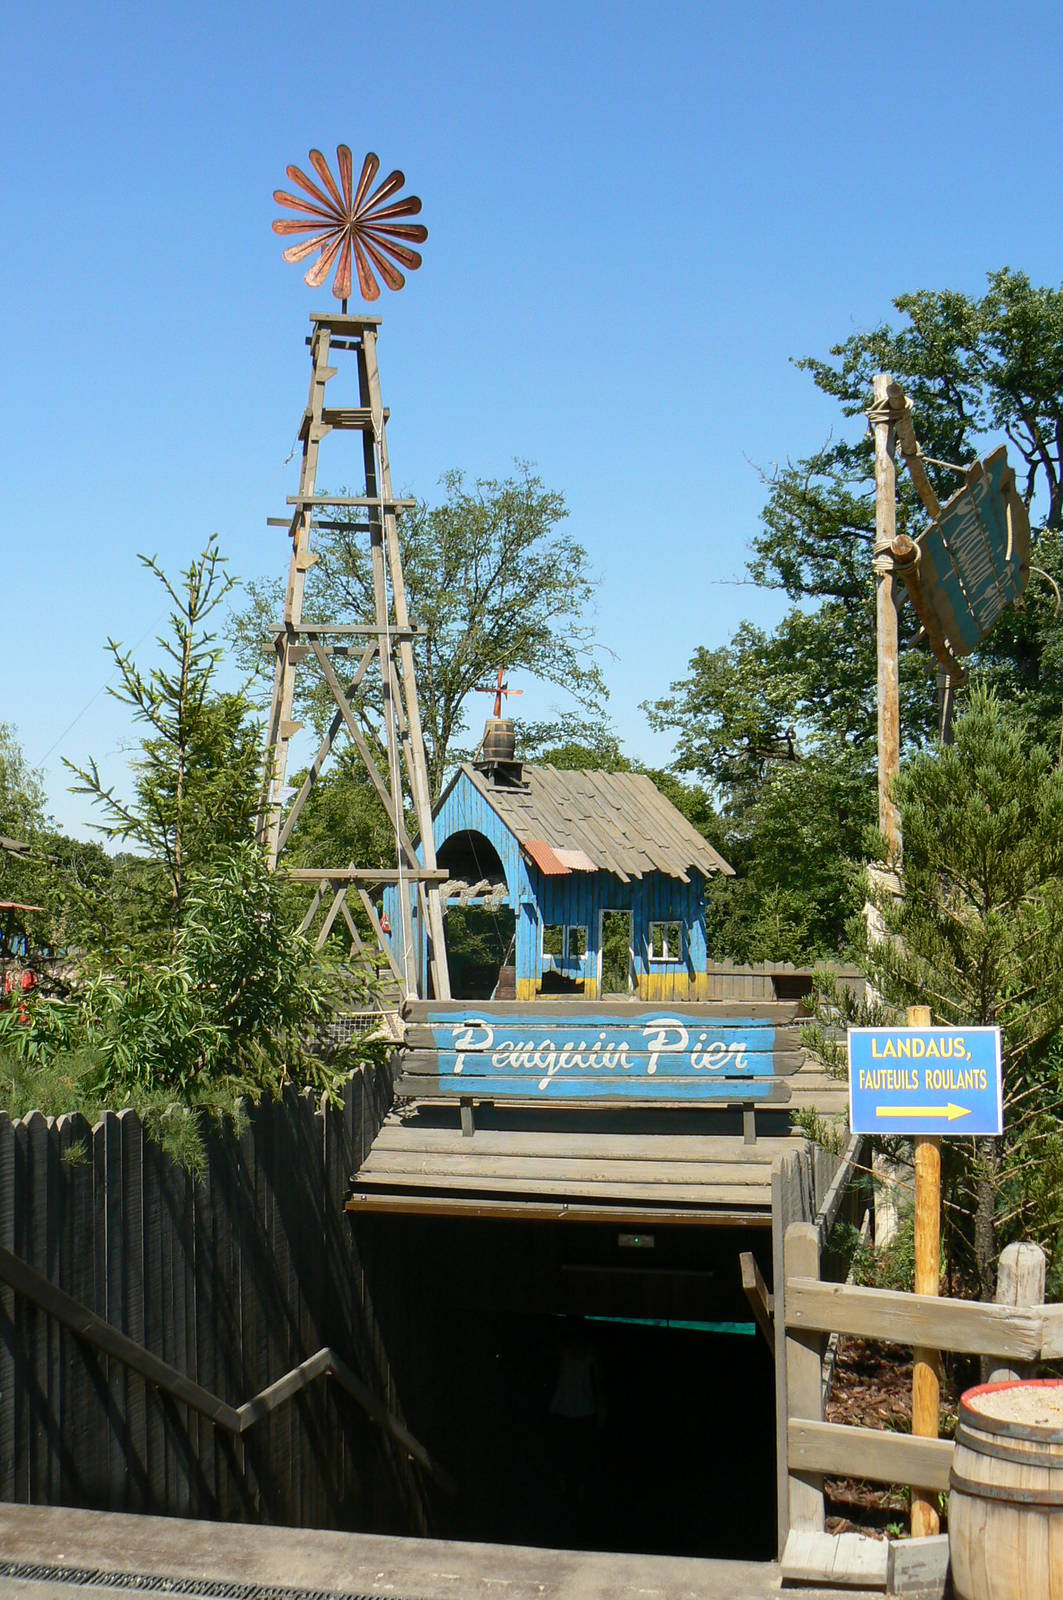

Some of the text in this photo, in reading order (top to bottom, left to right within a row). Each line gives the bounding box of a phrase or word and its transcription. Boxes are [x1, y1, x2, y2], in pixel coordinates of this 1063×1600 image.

[451, 1018, 748, 1091] Penguin Pier
[871, 1037, 972, 1062] LANDAUS,
[859, 1069, 988, 1091] FAUTEUILS ROULANTS
